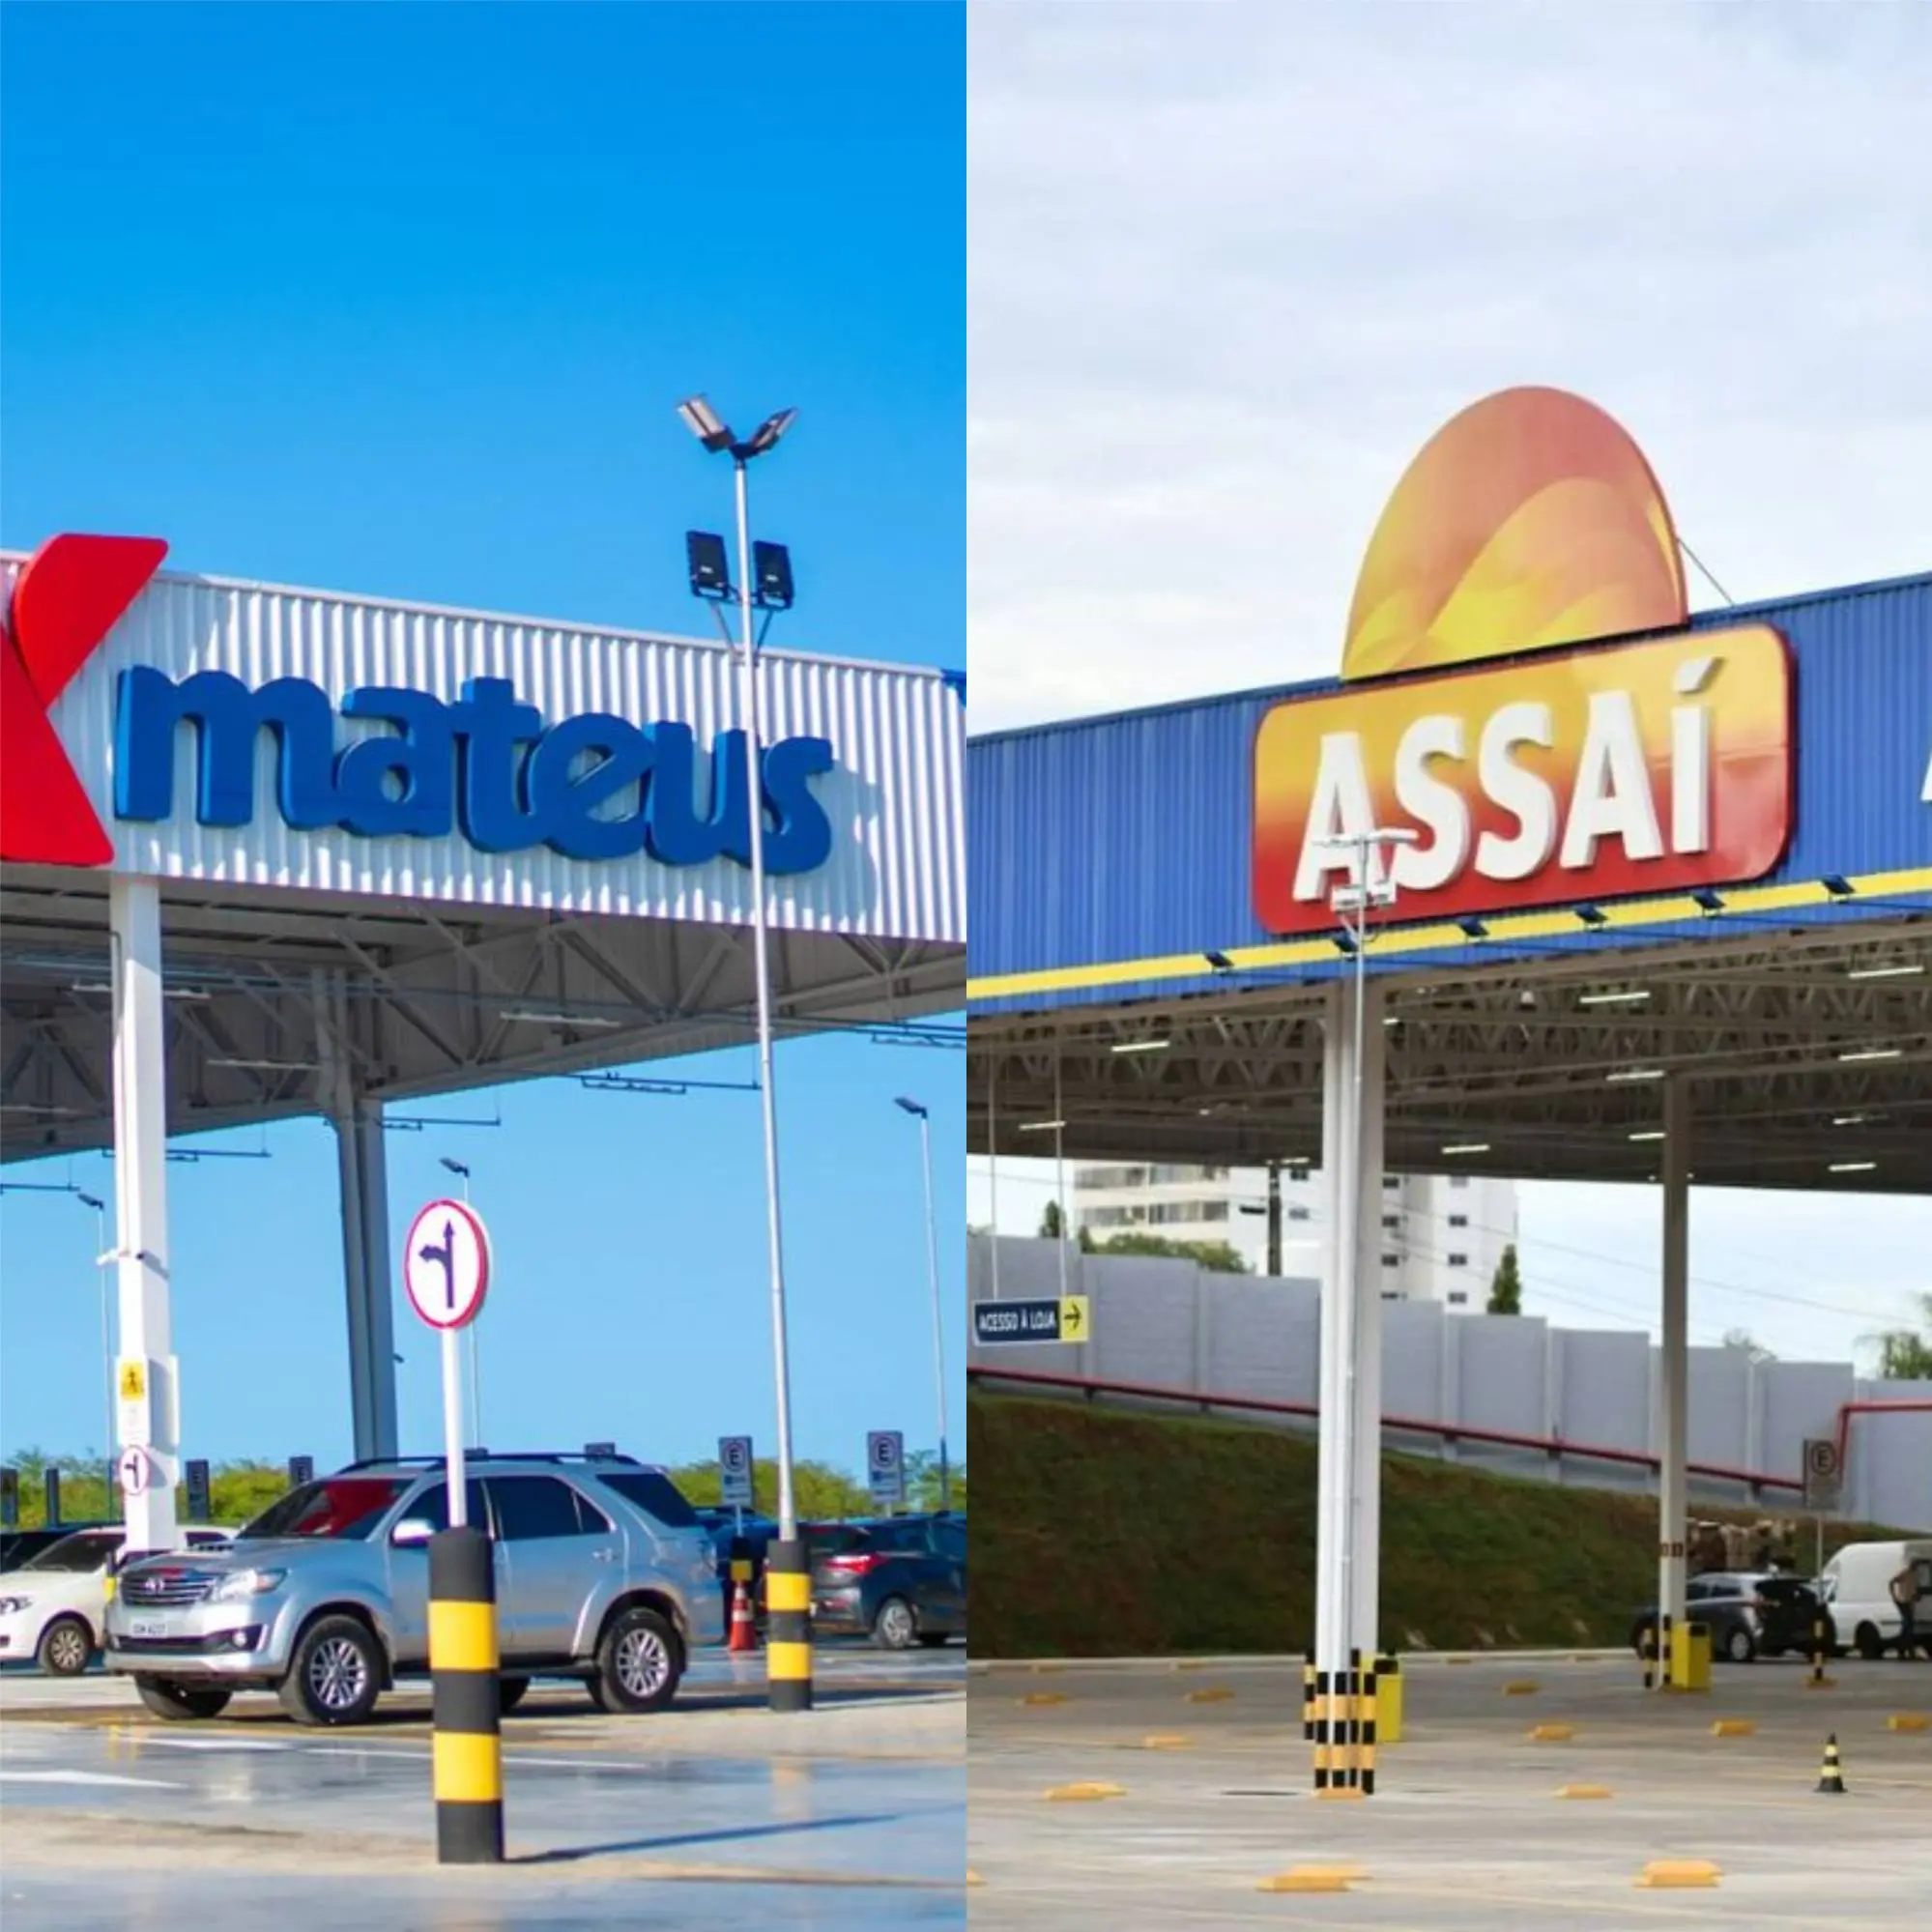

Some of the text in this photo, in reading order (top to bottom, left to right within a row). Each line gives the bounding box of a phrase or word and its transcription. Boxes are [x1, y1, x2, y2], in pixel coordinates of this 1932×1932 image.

[113, 664, 834, 877] mateus
[1291, 656, 1724, 904] ASSAÍ
[979, 1312, 1019, 1332] ACESSO
[1030, 1311, 1056, 1330] LOJA
[879, 1443, 889, 1462] E
[1818, 1450, 1829, 1467] E
